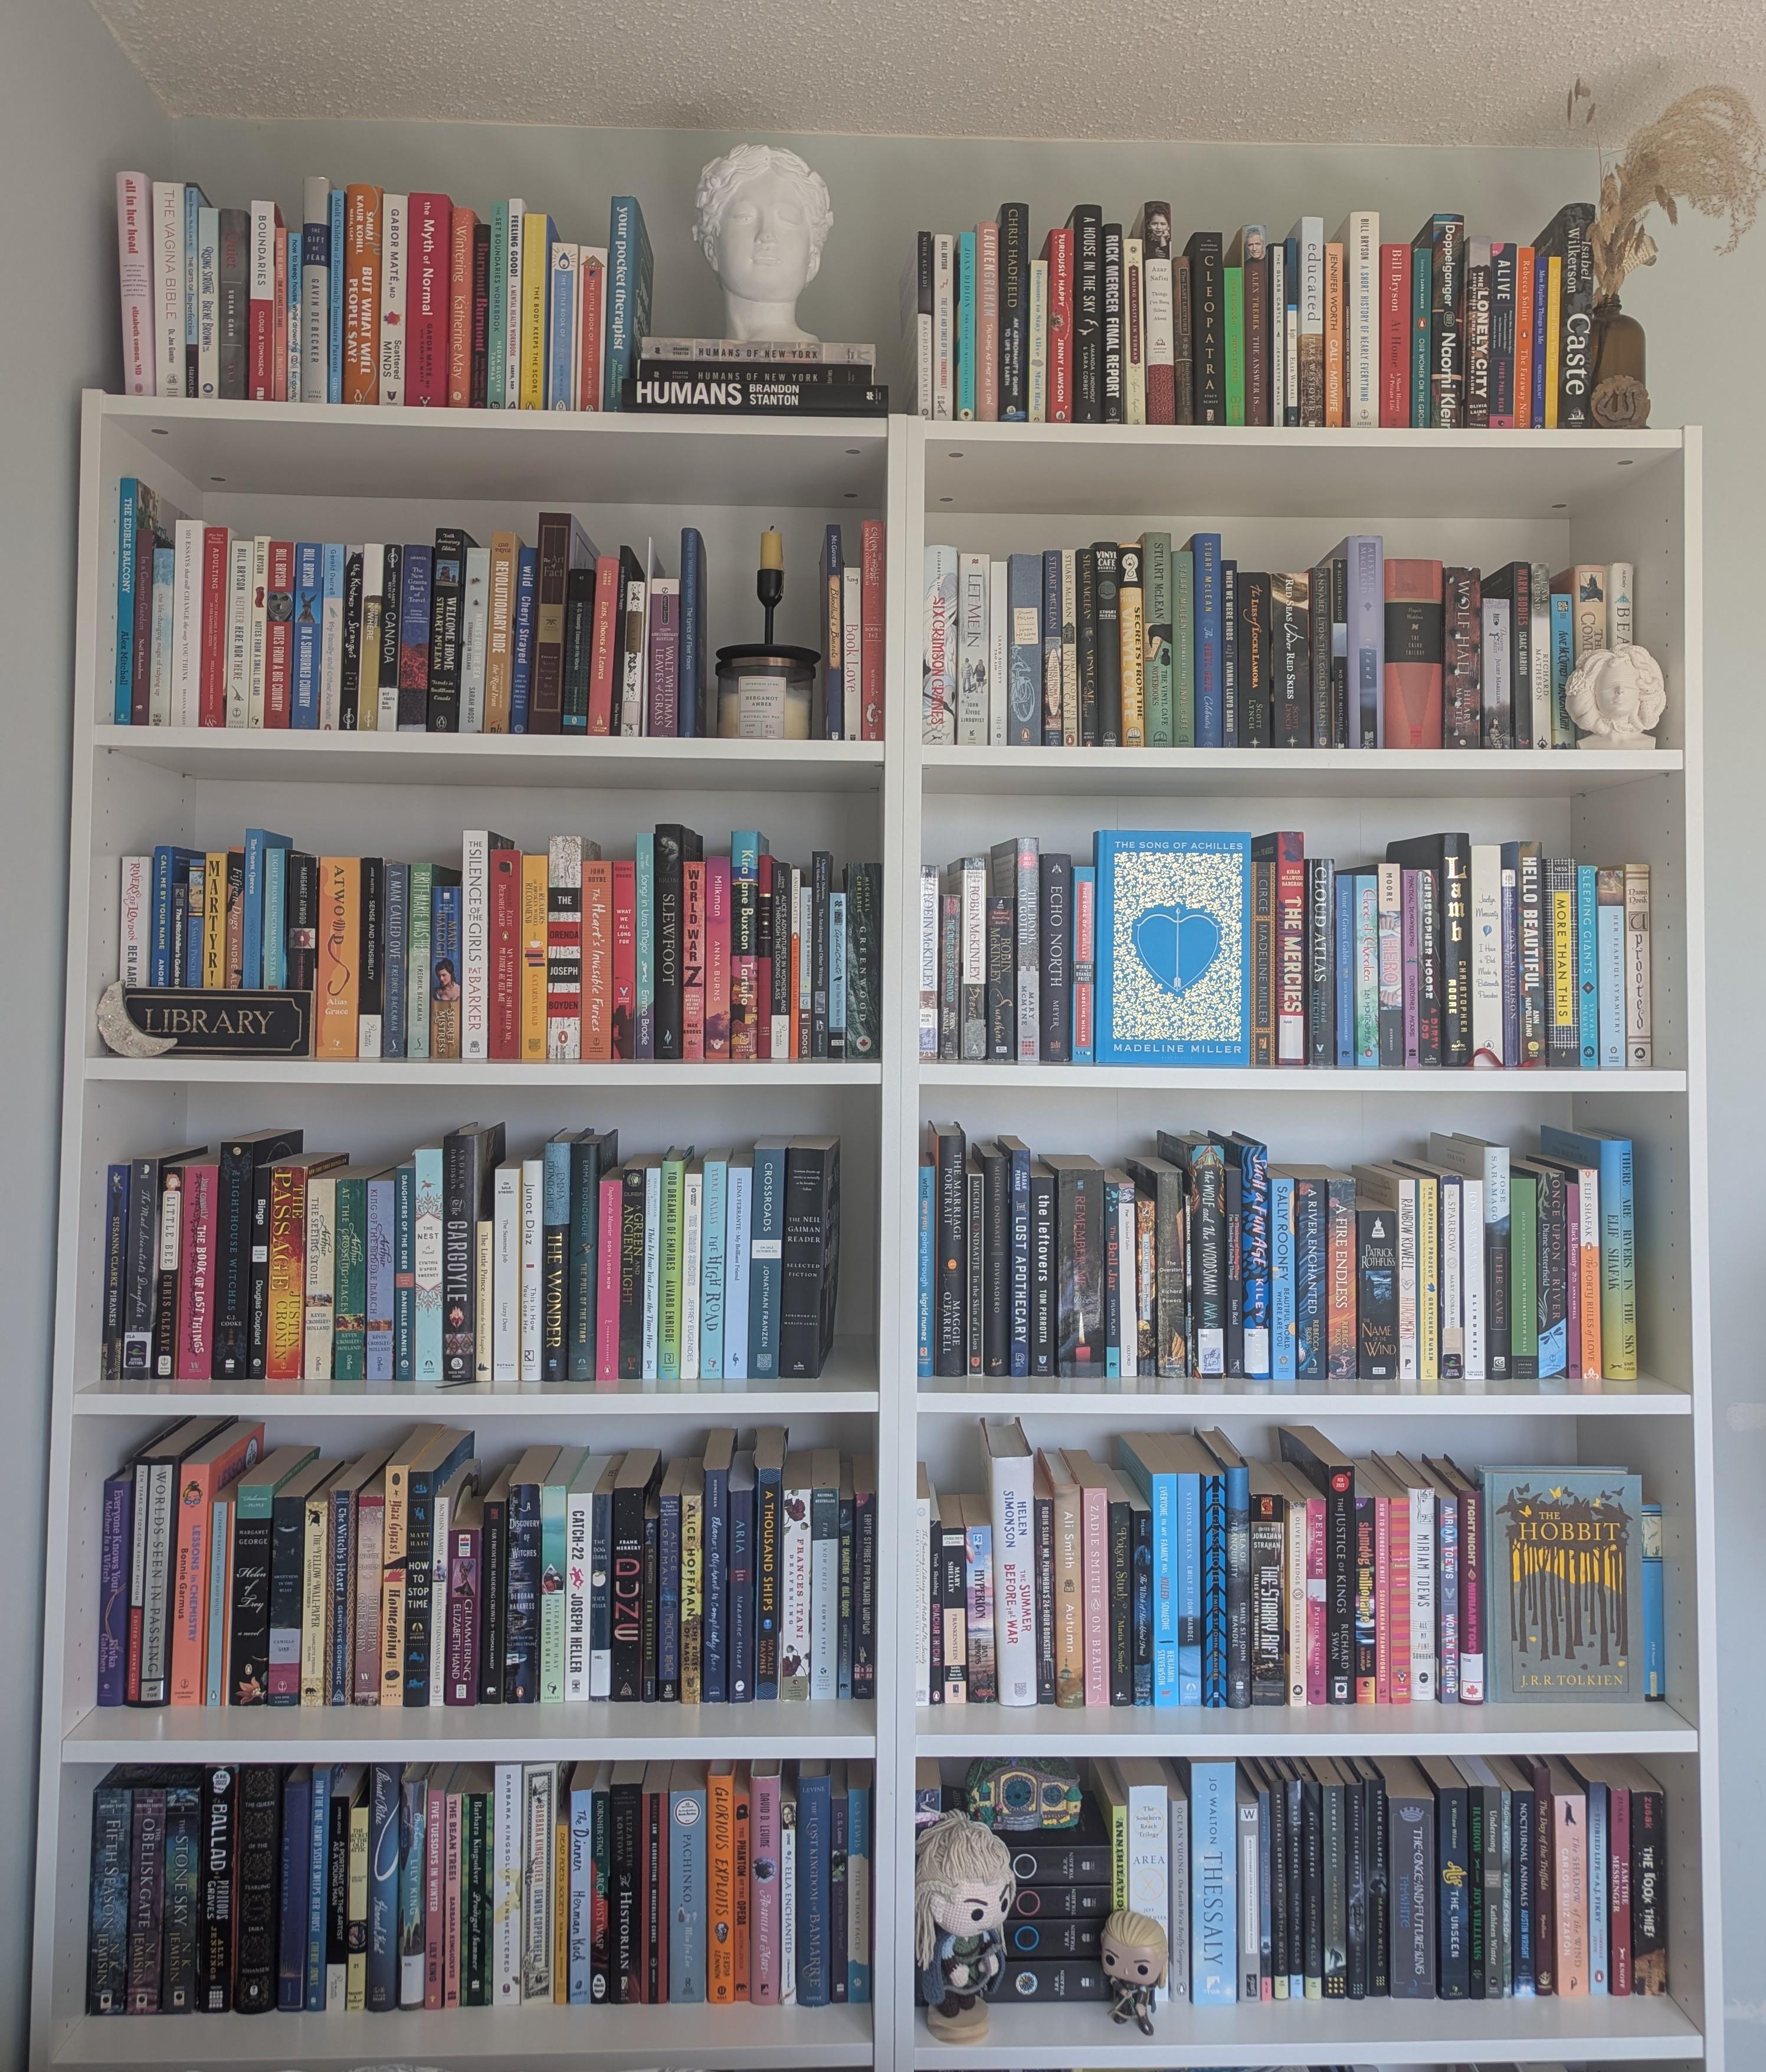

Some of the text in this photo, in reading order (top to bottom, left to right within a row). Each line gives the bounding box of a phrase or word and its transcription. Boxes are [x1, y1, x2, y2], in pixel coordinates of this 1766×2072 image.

[126, 179, 136, 192] all
[126, 195, 137, 205] in
[127, 208, 137, 226] her
[127, 229, 139, 254] head
[258, 215, 267, 286] BOUNDARIES
[421, 219, 435, 252] Myth
[423, 256, 431, 265] of
[1007, 209, 1018, 308] CHRIS HADFIELD
[1442, 225, 1455, 306] Doppelganger
[422, 268, 434, 316] Normal
[612, 207, 628, 349] your pocket therapist
[1307, 243, 1321, 321] educated
[1497, 260, 1511, 300] ALIVE
[1106, 235, 1120, 399] RICK MERCER FINAL REPORT
[1204, 256, 1215, 389] CLEOPATRA
[699, 348, 818, 359] HUMANS OF NEW YORK
[1441, 332, 1456, 388] Naomi
[1566, 313, 1591, 395] Caste
[636, 381, 742, 405] HUMANS
[749, 384, 800, 394] BRANDON
[750, 395, 799, 405] STANTON
[122, 497, 132, 593] THE EDIBLE BALCONY
[493, 560, 509, 653] REVOLUTIONARY RIDE
[967, 574, 982, 647] LET ME IN
[1457, 580, 1470, 677] WOLF HALL
[1518, 569, 1528, 626] WARM BODIES
[384, 612, 396, 664] CANADA
[444, 597, 457, 670] WELCOME HOME
[846, 623, 860, 693] Book Love
[931, 595, 945, 725] SIX CRIMSON CRANES
[1139, 841, 1169, 849] SONG
[208, 860, 220, 987] MARTYR!
[558, 896, 572, 905] THE
[684, 869, 702, 987] WORLD WAR Z
[1259, 880, 1267, 912] CIRCE
[550, 930, 579, 939] ORENDA
[661, 894, 674, 986] SLEWFOOT
[1049, 885, 1062, 987] ECHO NORTH
[1284, 896, 1302, 1012] THE MERCIES
[1383, 939, 1398, 984] HERO
[1557, 899, 1568, 1017] MORE THAN THIS
[550, 967, 578, 976] JOSEPH
[741, 963, 753, 1006] Tartufo
[145, 1009, 274, 1034] LIBRARY
[1113, 1043, 1241, 1053] MADELINE MILLER
[165, 1197, 175, 1264] LITTLE BEE
[255, 1199, 266, 1225] Binge
[272, 1171, 291, 1289] PASSAGE
[292, 1185, 303, 1218] THE
[764, 1163, 772, 1232] CROSSROADS
[447, 1221, 467, 1302] GARGOYLE
[1038, 1194, 1050, 1282] the leftovers
[1277, 1186, 1289, 1281] SALLY ROONEY
[1362, 1256, 1395, 1268] ROTHFUSS
[1365, 1245, 1393, 1257] PATRICK
[546, 1233, 562, 1348] THE WONDER
[919, 1292, 929, 1315] sigrid
[1015, 1217, 1027, 1343] LOST APOTHECARY
[572, 1511, 585, 1560] CATCH-22
[1003, 1490, 1015, 1548] SIMONSON
[1017, 1501, 1027, 1536] HELEN
[1064, 1511, 1073, 1568] Ali Smith
[1445, 1507, 1454, 1579] MIRIAM TOEWS
[1519, 1523, 1621, 1540] HOBBIT
[1539, 1511, 1560, 1520] THE
[148, 1471, 167, 1672] WORLDS SEEN IN PASSING
[764, 1491, 774, 1612] A THOUSAND SHIPS
[385, 1589, 401, 1658] Homegoing
[408, 1600, 428, 1608] TIME
[614, 1559, 640, 1641] DUNE
[975, 1570, 986, 1619] HYPERION
[1260, 1565, 1279, 1660] THE STARRY RIFT
[570, 1593, 583, 1673] JOSEPH HELLER
[1446, 1613, 1454, 1693] WOMEN TALKING
[1521, 1675, 1623, 1687] J.R.R. TOLKIEN
[573, 1809, 589, 1871] The Dinner
[1208, 1778, 1217, 1844] JO WALTON
[1488, 1810, 1497, 1852] Undersong
[103, 1820, 121, 1930] FIFTH SEASON
[430, 1801, 440, 1912] FIVE TUESDAYS IN WINTER
[683, 1834, 692, 1903] PACHINKO
[715, 1787, 730, 1917] GLORIOUS EXPLOITS
[1133, 1855, 1165, 1864] AREA
[1519, 1803, 1528, 1907] NOCTURNAL ANIMALS
[1204, 1852, 1223, 1966] THESSALY
[1450, 1890, 1460, 1958] THE UNSEEN
